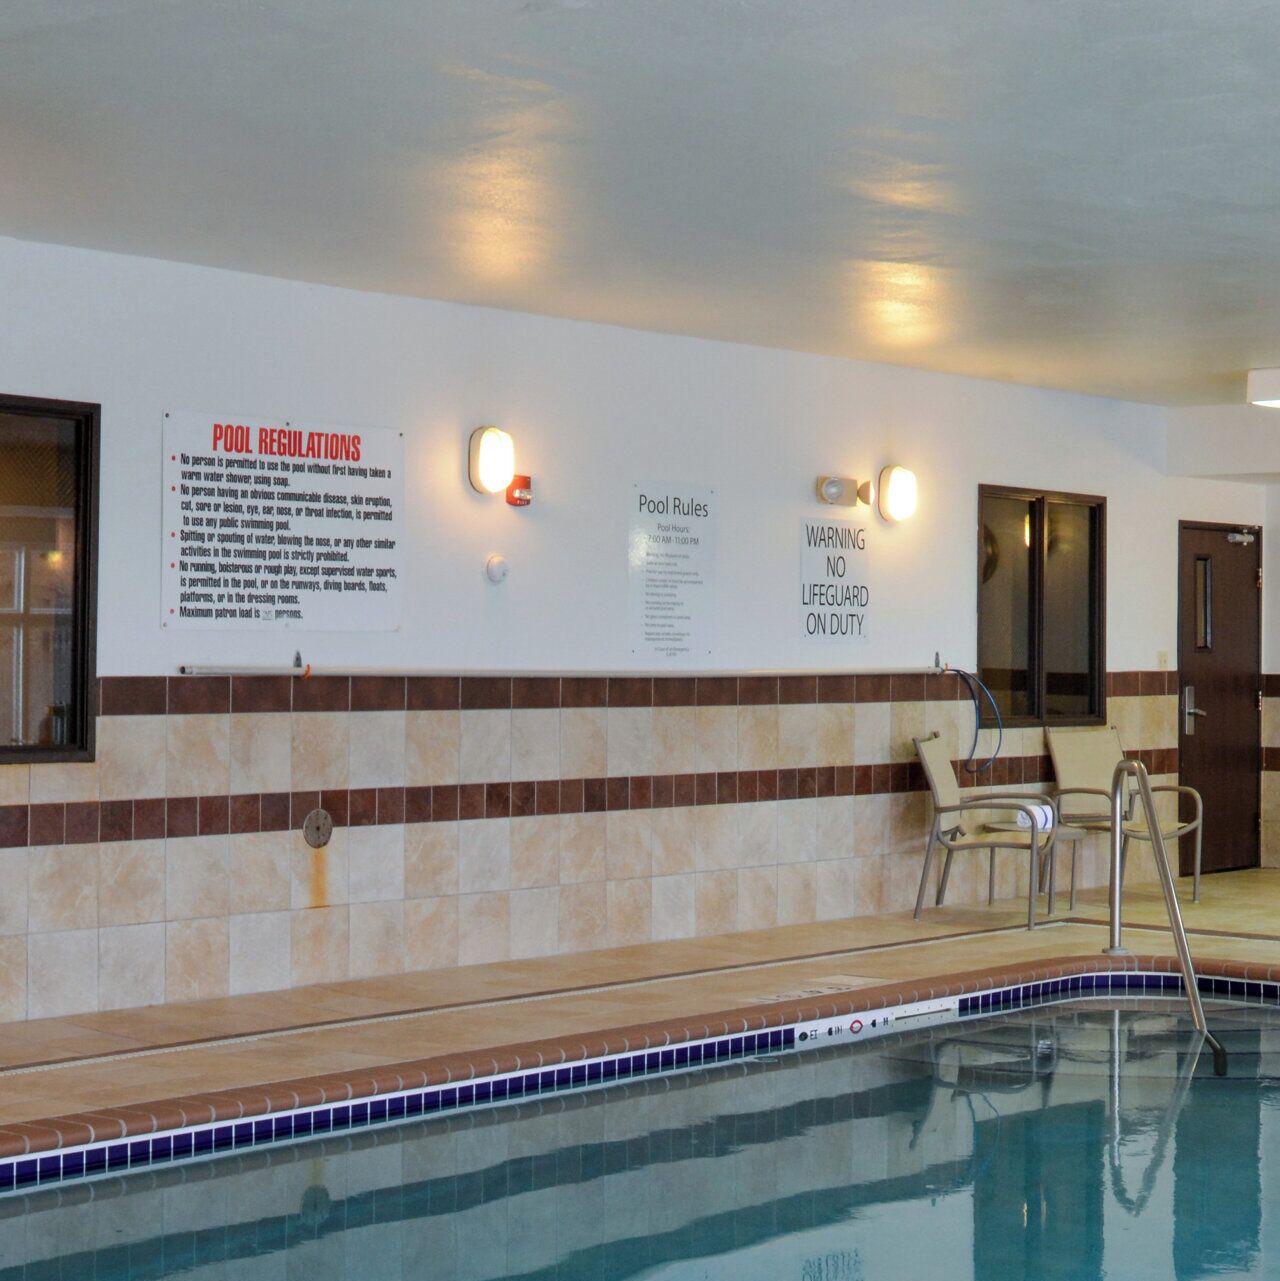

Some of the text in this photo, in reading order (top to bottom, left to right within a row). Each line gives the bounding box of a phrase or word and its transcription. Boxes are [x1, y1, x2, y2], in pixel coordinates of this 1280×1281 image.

[213, 423, 361, 462] POOL REGULATIONS
[639, 494, 708, 517] Pool Rules
[806, 524, 865, 550] WARNING
[827, 556, 846, 577] NO
[802, 583, 869, 607] LIFEGUARD
[806, 612, 864, 635] ON DUTY
